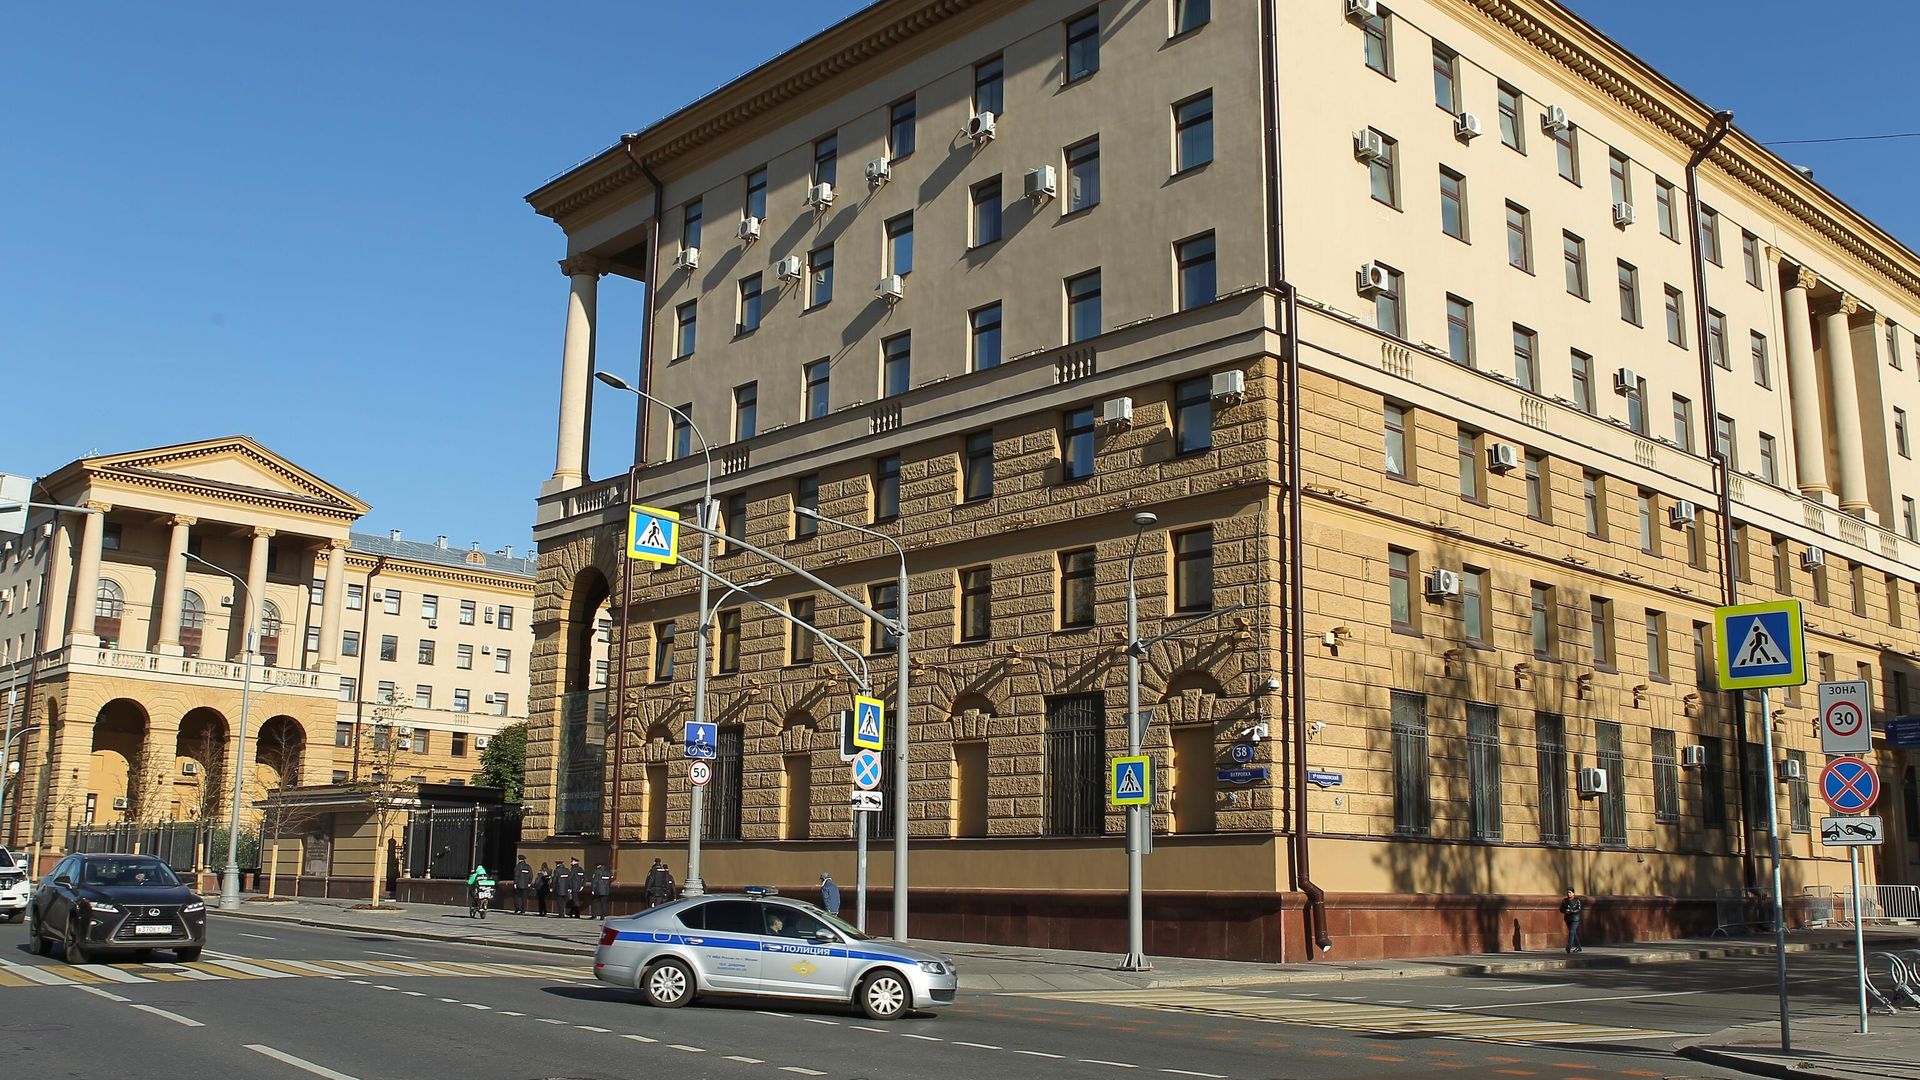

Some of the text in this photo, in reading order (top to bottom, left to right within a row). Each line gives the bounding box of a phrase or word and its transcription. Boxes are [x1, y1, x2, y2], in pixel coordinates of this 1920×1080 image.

[1829, 686, 1856, 695] ЗОНА
[1834, 712, 1854, 725] 30
[1236, 747, 1247, 757] 38
[694, 768, 706, 778] 50
[782, 945, 831, 956] ПОЛИЦИЯ
